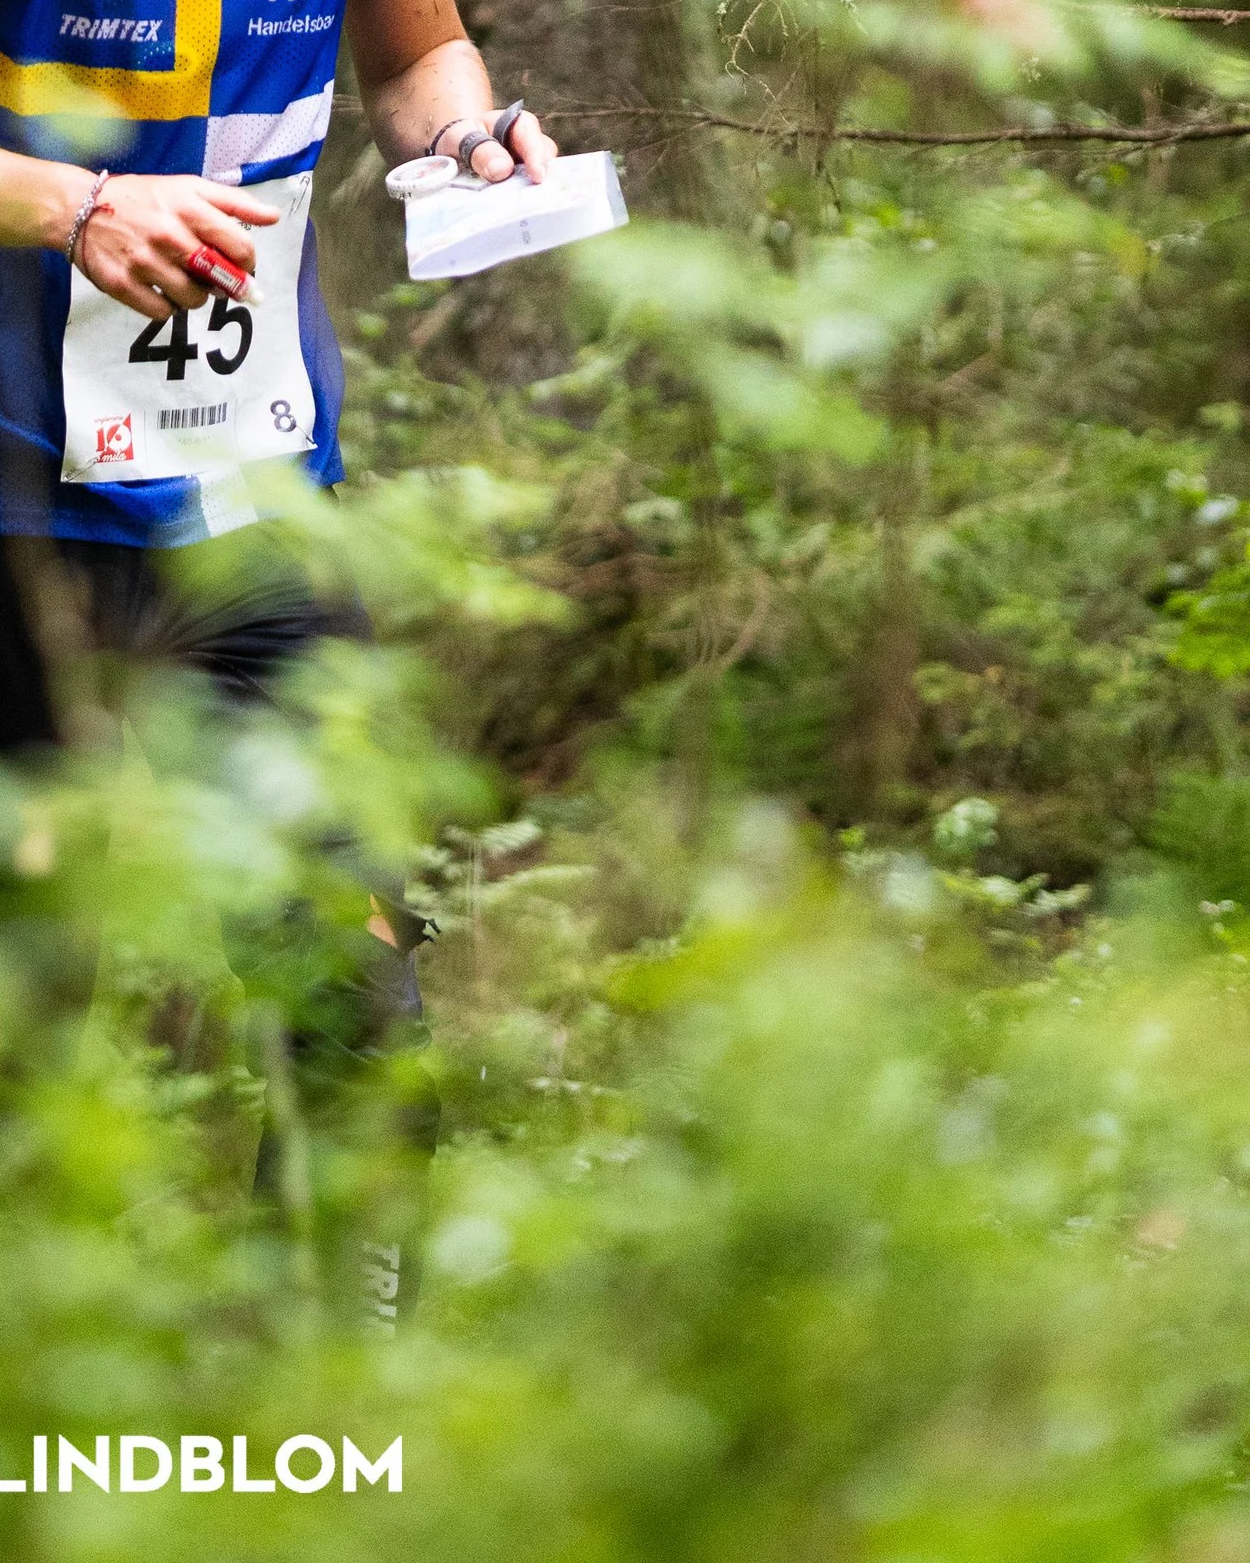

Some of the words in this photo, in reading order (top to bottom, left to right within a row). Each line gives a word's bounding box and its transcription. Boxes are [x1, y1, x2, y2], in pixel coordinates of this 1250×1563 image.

[59, 13, 163, 42] TRIMTEX
[128, 278, 253, 381] 45
[270, 399, 297, 433] 8
